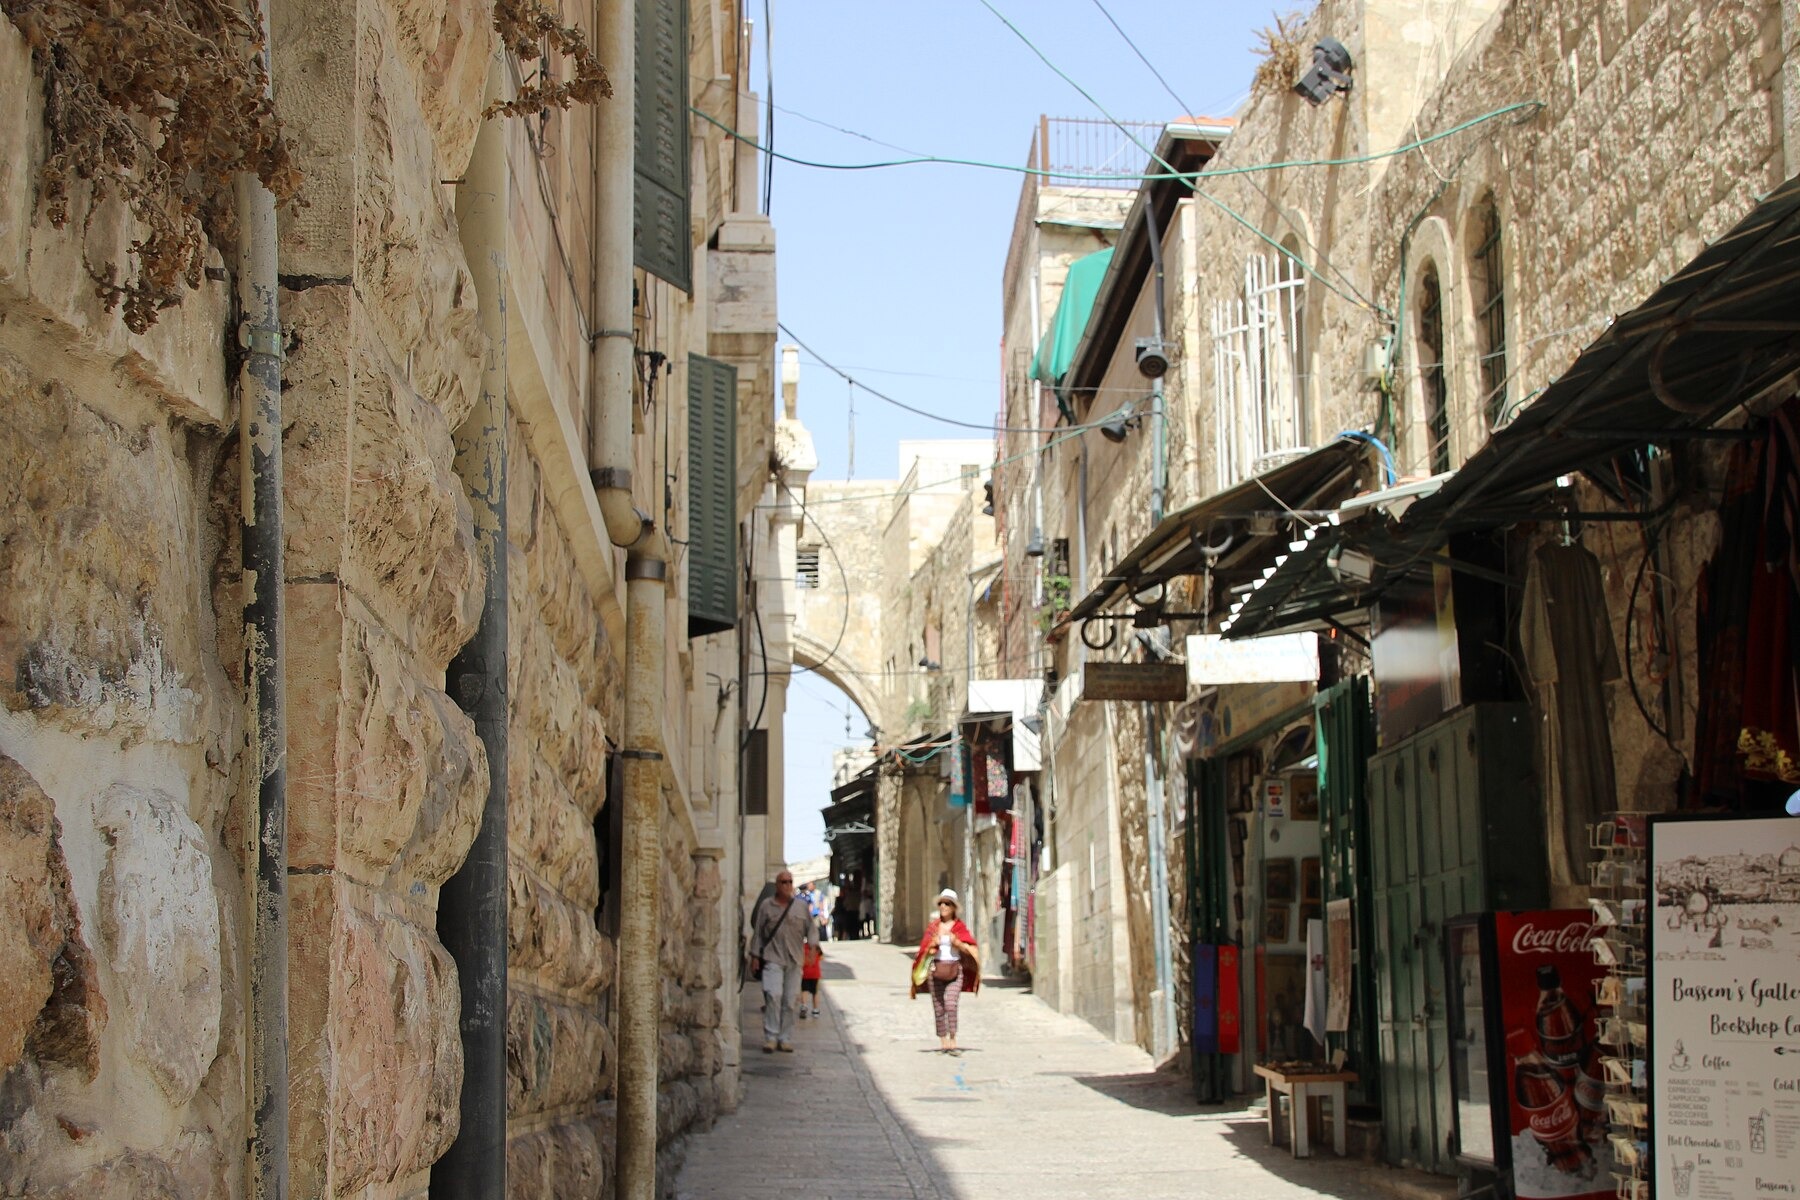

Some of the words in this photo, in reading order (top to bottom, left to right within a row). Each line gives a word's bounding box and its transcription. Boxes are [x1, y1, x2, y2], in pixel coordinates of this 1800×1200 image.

[1512, 922, 1594, 954] Coca-Cola
[1673, 978, 1744, 1002] Bassem's
[1751, 978, 1800, 1008] Galle
[1711, 1014, 1779, 1039] Bookshop
[1702, 1054, 1731, 1070] Coffee
[1773, 1077, 1794, 1091] Cold
[1668, 1135, 1682, 1147] Hot
[1684, 1135, 1721, 1148] Chocolate
[1755, 1177, 1795, 1193] Bassem's
